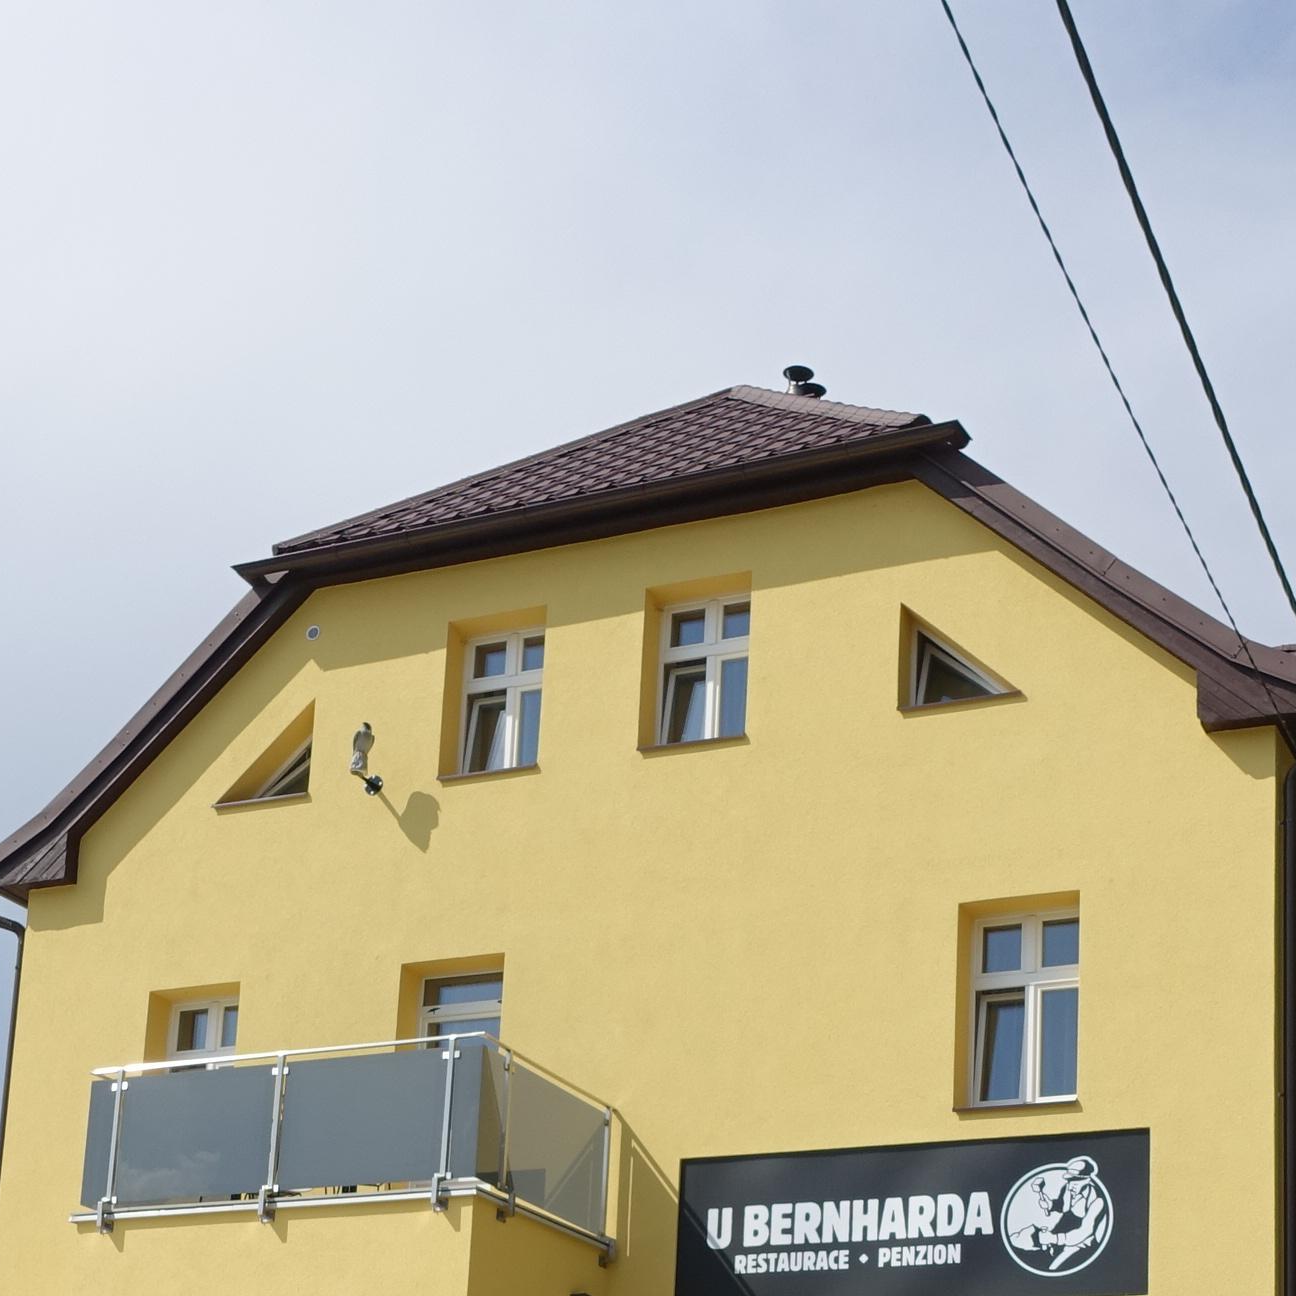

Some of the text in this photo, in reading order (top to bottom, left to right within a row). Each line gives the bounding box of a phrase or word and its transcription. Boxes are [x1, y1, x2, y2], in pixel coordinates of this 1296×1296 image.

[706, 1191, 994, 1250] U BERNHARDA
[734, 1243, 962, 1275] RESTAURACE PENZION
